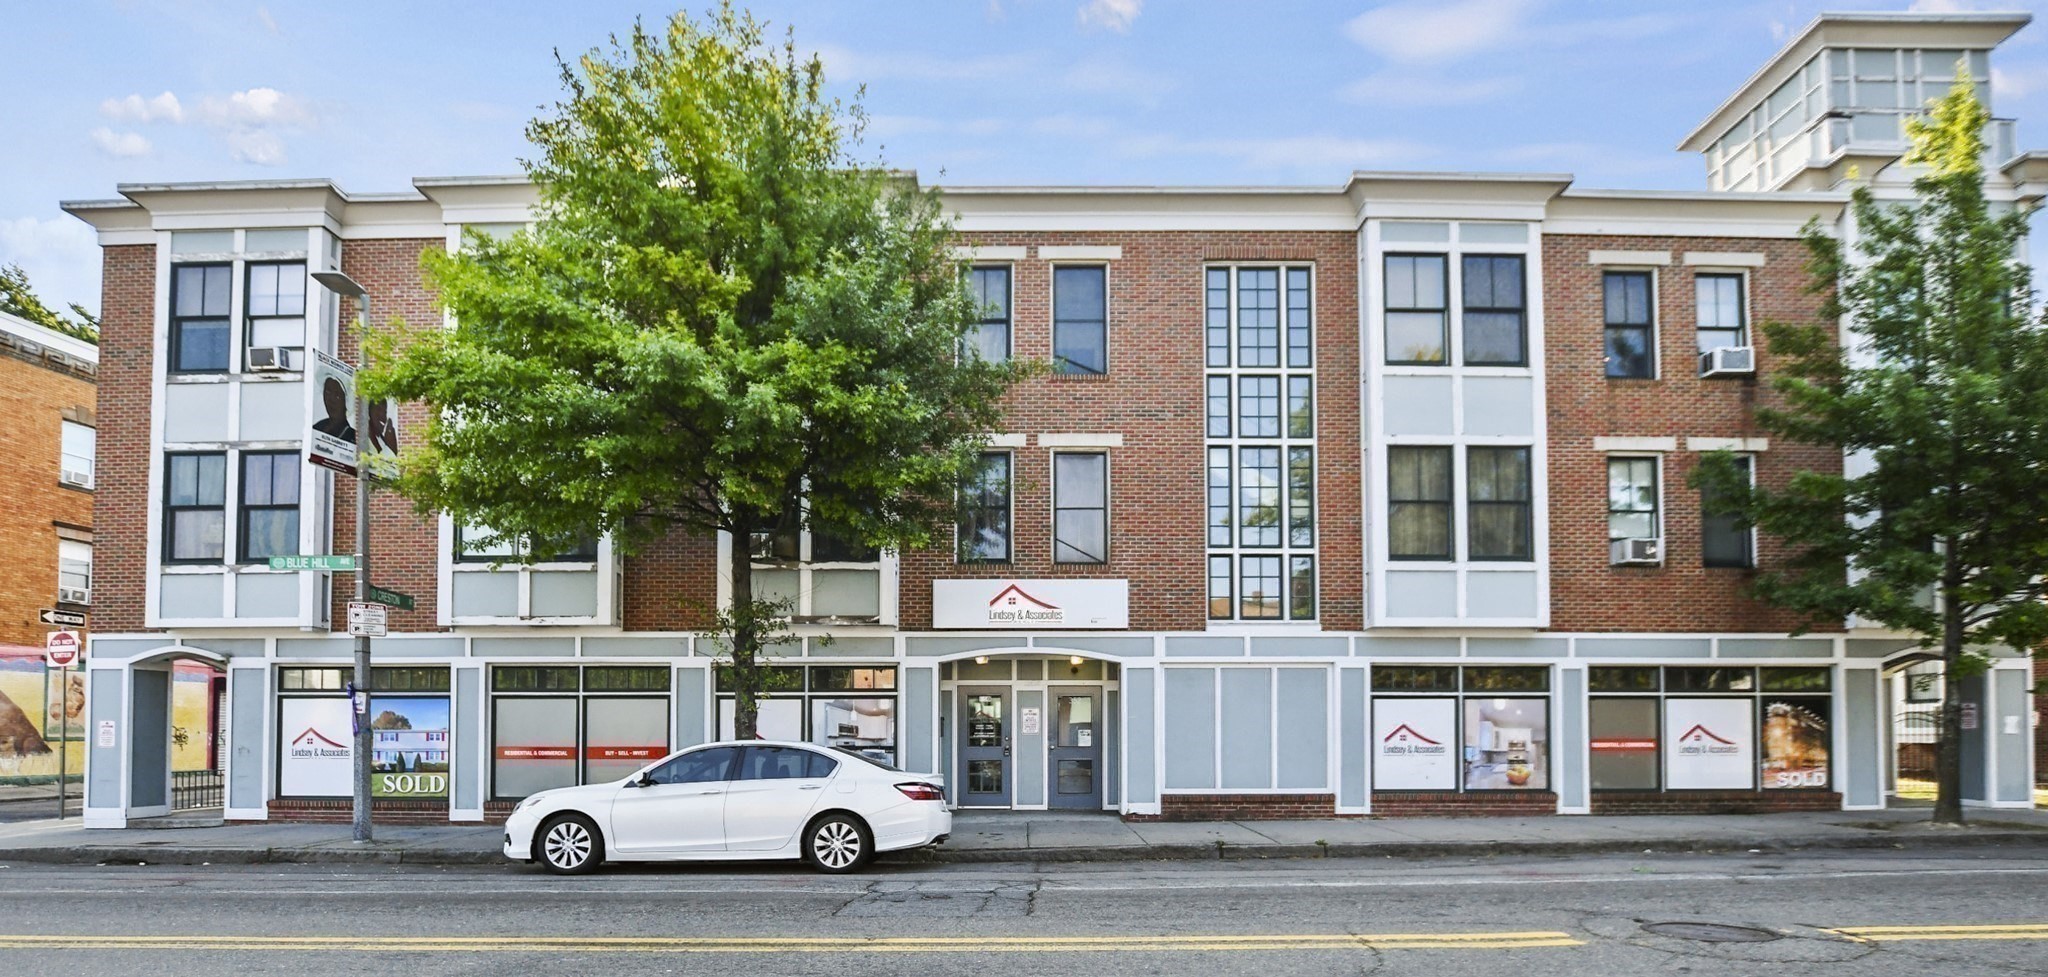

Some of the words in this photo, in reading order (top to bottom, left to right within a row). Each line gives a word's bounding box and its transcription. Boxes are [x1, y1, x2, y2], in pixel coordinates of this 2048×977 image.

[286, 557, 309, 568] BLUE
[311, 557, 330, 568] HILL
[377, 590, 400, 605] CRESTON
[989, 610, 1015, 621] Lindsey
[1017, 610, 1024, 620] &
[1025, 609, 1063, 620] Associates
[291, 748, 313, 757] Lindsey
[314, 748, 319, 757] &
[320, 748, 350, 757] Associates
[1383, 745, 1406, 755] Lindsey
[1414, 745, 1445, 754] Associates
[382, 774, 446, 794] SOLD
[1776, 772, 1827, 787] SOLD
